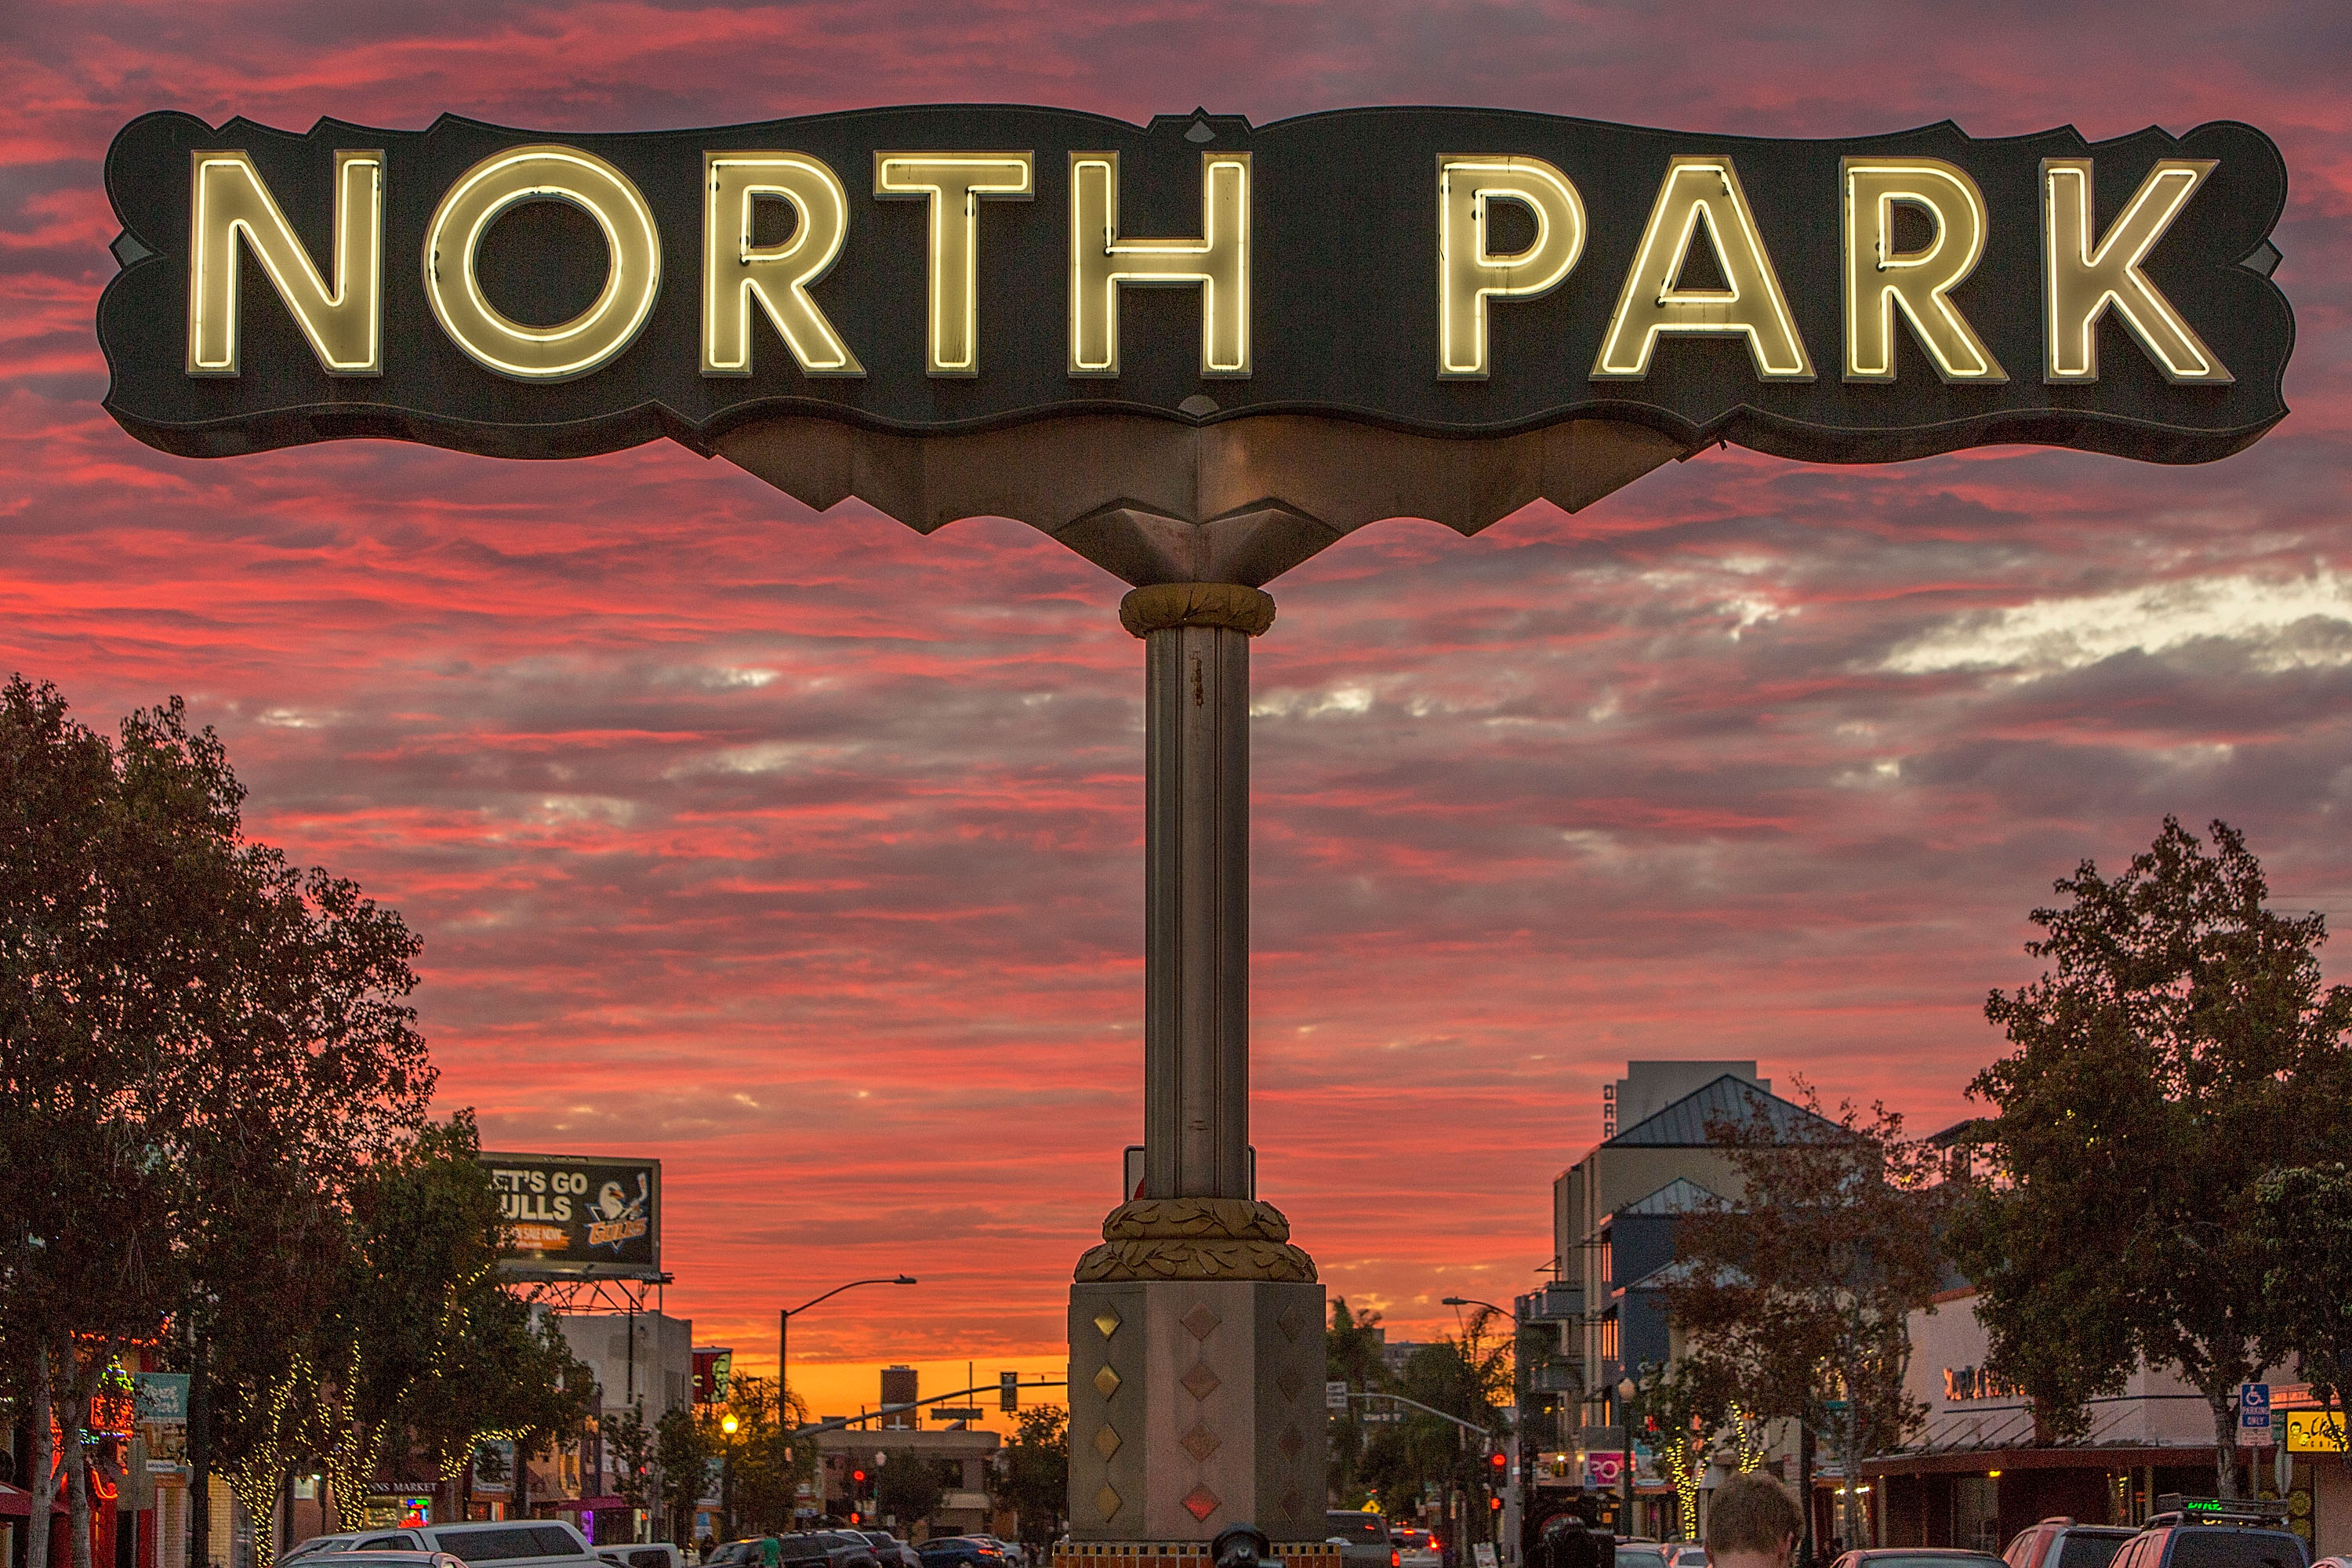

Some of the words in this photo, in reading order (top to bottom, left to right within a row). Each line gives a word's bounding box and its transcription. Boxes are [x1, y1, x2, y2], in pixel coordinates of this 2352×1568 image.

[186, 143, 1252, 383] NORTH
[1436, 151, 2236, 384] PARK
[492, 1169, 546, 1193] ET'S
[551, 1171, 588, 1195] GO
[500, 1193, 572, 1221] ULLS
[542, 1229, 562, 1241] NOW
[590, 1218, 648, 1246] GULLS
[2247, 1416, 2265, 1425] ONLY
[393, 1482, 437, 1492] MARKET
